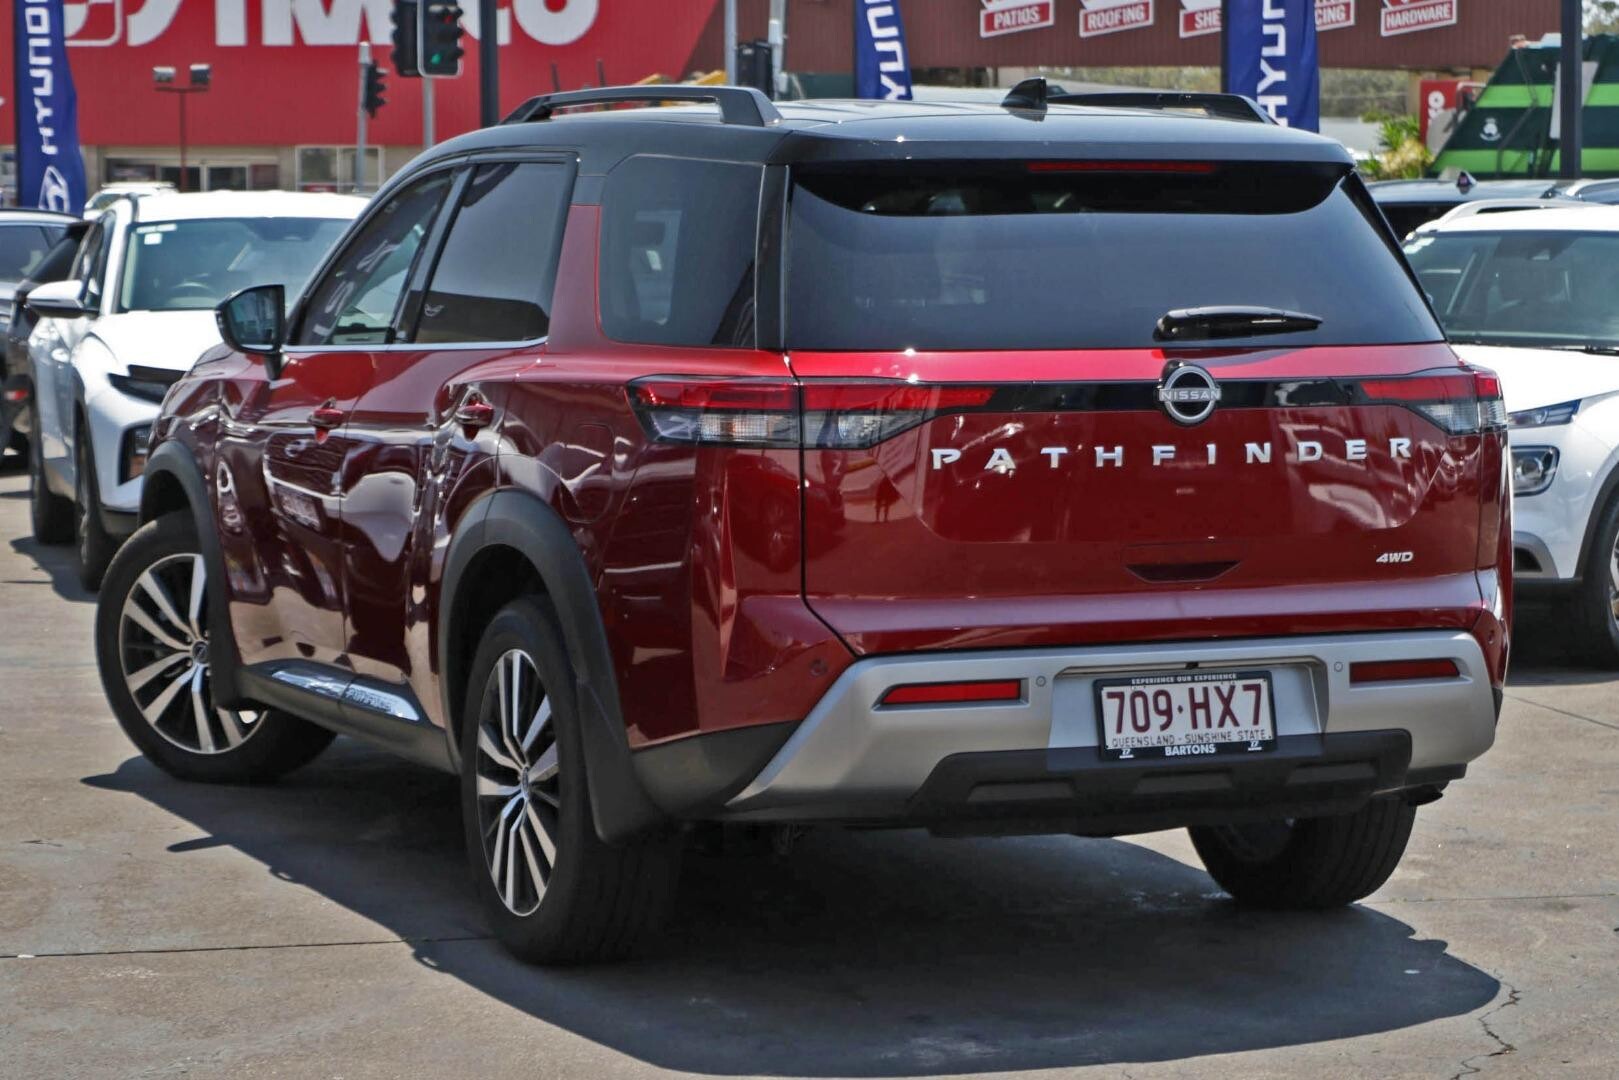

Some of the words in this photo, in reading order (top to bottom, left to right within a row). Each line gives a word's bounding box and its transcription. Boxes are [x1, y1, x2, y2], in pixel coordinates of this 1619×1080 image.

[993, 6, 1040, 29] PATIOS
[1087, 5, 1145, 30] ROOFING
[1386, 5, 1451, 28] HARDWARE
[25, 0, 59, 155] HYUND
[1161, 390, 1219, 400] NISSAN
[931, 437, 1413, 471] PATHFINDER
[1376, 551, 1414, 563] 4WD
[1112, 733, 1176, 748] QUEENSLAND
[1184, 731, 1232, 744] SUNSHINE
[1237, 729, 1265, 741] STATE
[1164, 743, 1216, 757] BARTONS
